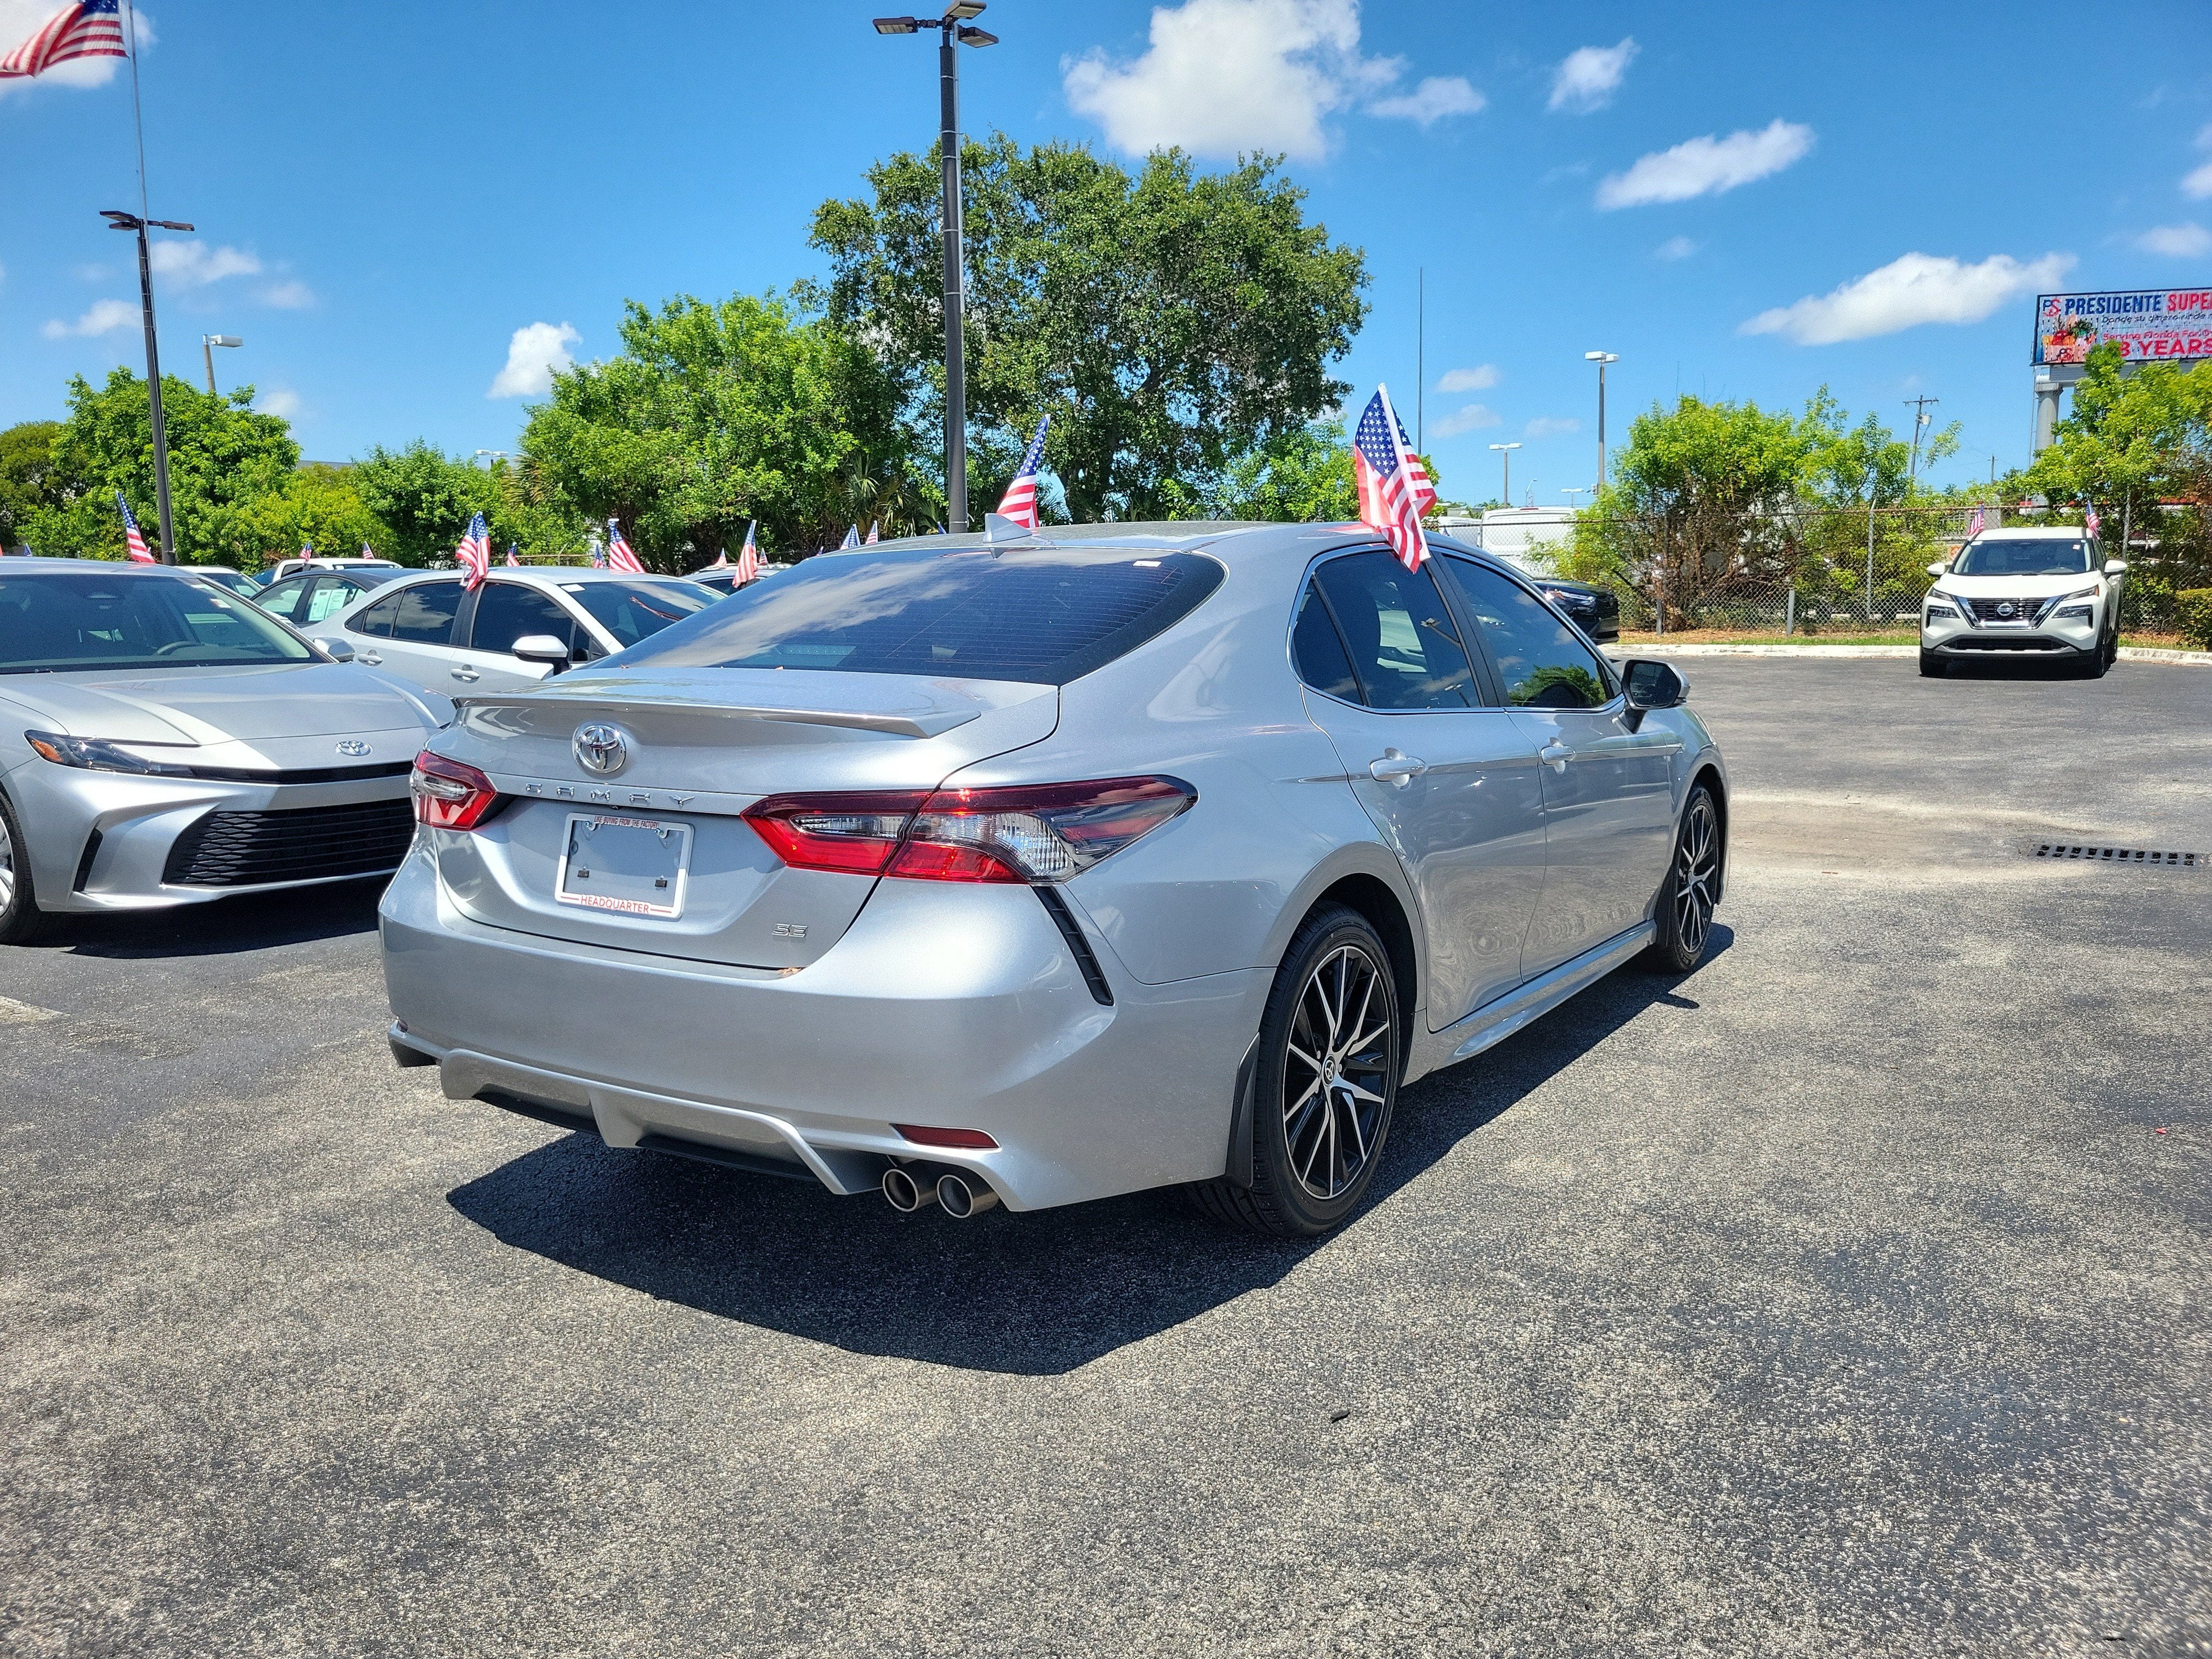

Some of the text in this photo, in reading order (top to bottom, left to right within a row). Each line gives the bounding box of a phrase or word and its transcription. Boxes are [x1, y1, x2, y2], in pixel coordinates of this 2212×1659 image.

[2065, 292, 2212, 315] PRESIDENTE SUPE
[2138, 338, 2212, 356] YEARS
[526, 783, 696, 806] CAMRY
[581, 894, 650, 913] HEADQUARTER
[771, 923, 808, 938] SE
